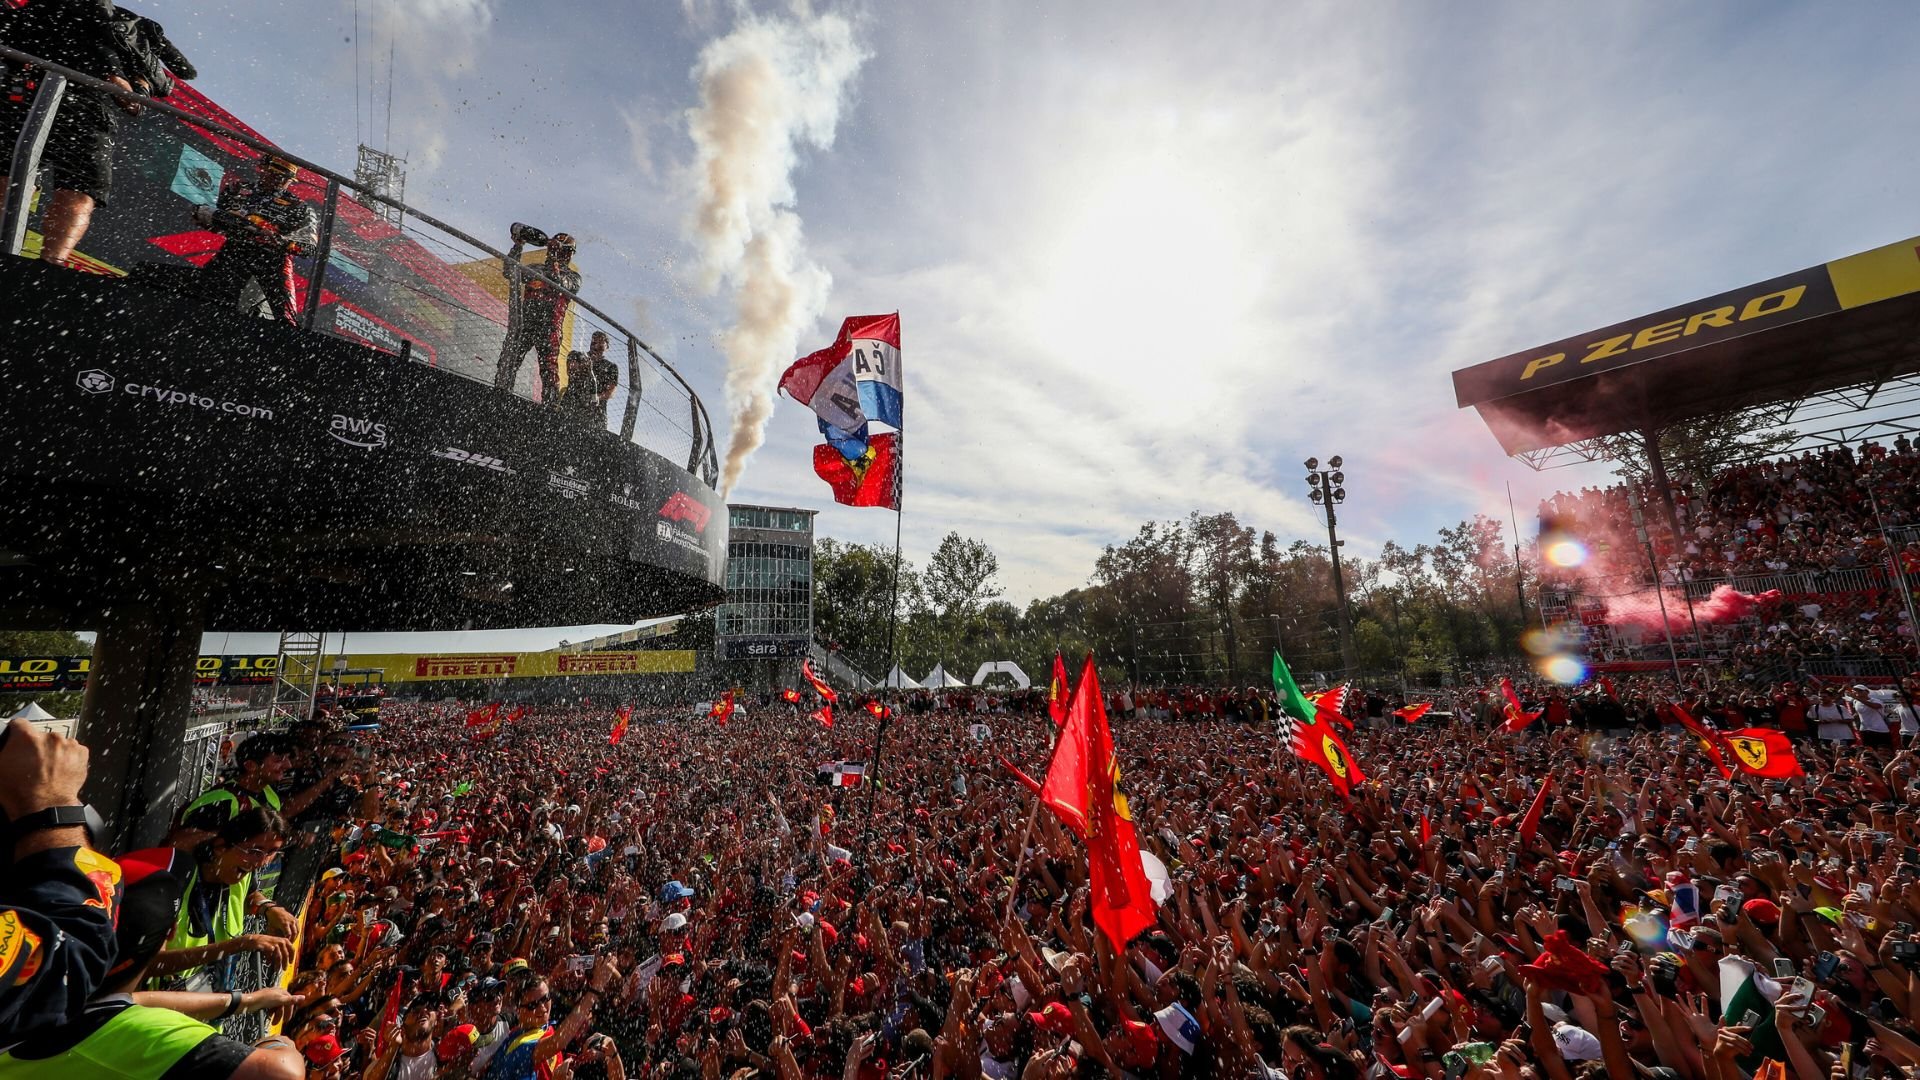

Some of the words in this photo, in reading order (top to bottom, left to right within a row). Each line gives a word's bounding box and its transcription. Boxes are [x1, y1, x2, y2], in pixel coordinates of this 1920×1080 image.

[1520, 353, 1565, 380] P
[1580, 285, 1807, 364] ZERO
[124, 381, 274, 421] crypto.com
[330, 414, 387, 438] aws
[444, 447, 509, 472] DHL
[550, 474, 588, 492] Heineken
[610, 493, 641, 511] ROLEX
[748, 643, 777, 654] sara
[196, 657, 223, 670] 0
[416, 656, 517, 677] PIRELLI
[557, 654, 638, 672] PIRELLI
